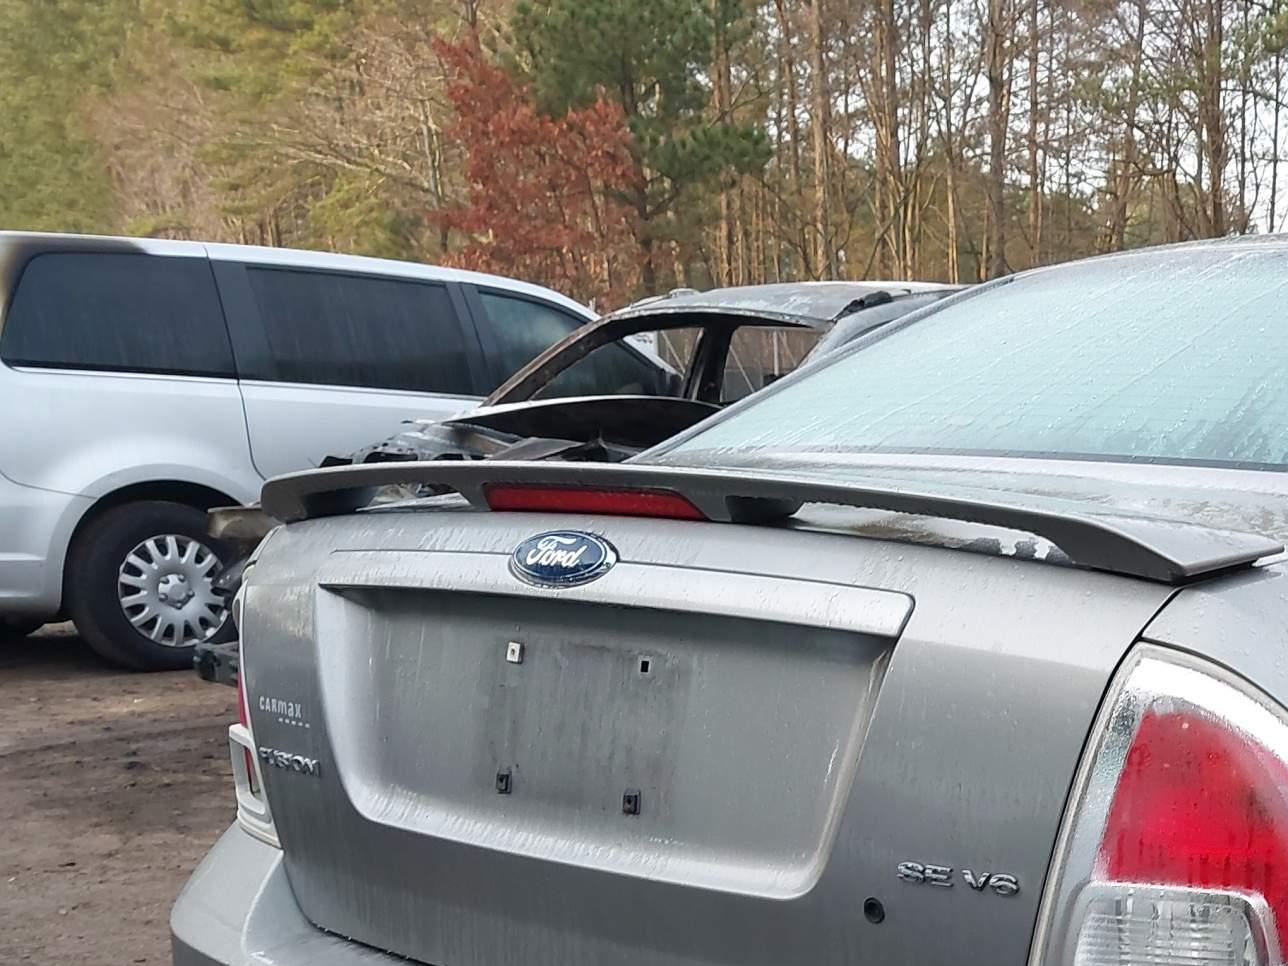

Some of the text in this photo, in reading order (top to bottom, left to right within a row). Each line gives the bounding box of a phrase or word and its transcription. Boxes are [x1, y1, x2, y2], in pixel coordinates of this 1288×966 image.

[526, 536, 587, 568] Ford
[897, 861, 1020, 895] SE V6
